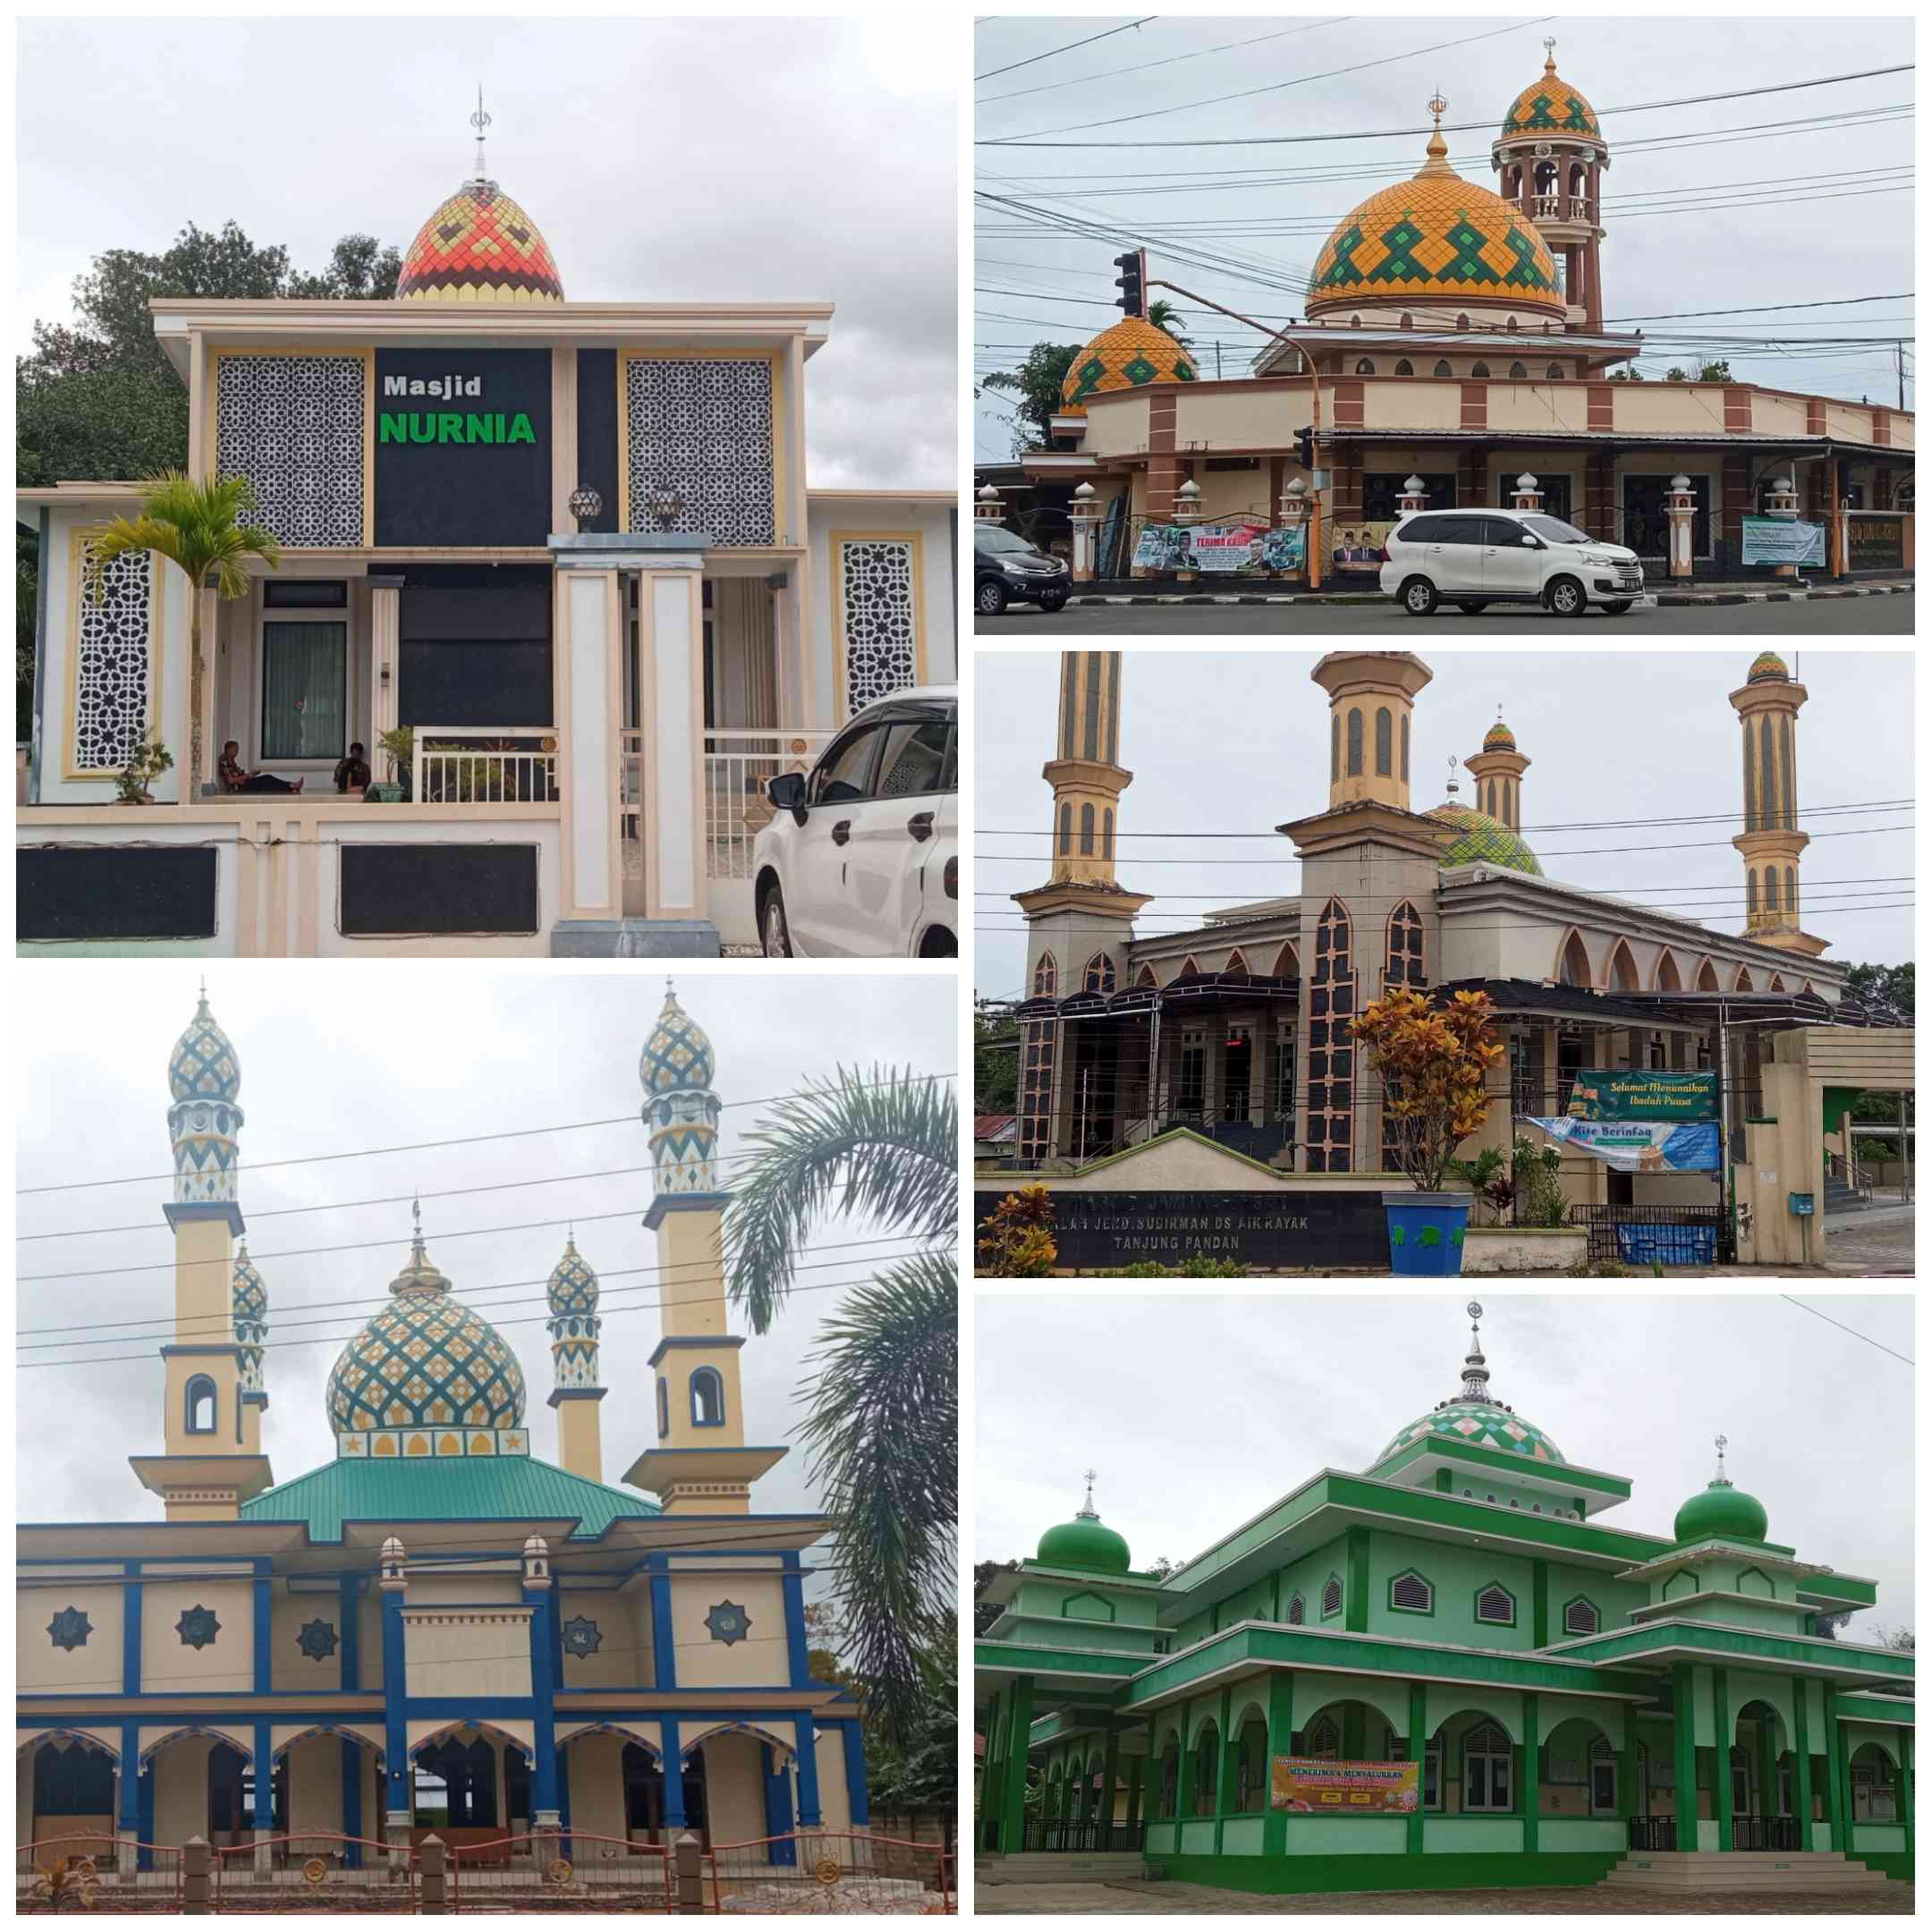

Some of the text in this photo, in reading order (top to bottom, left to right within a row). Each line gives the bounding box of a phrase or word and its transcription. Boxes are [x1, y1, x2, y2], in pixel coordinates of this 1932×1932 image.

[384, 375, 481, 401] Masjid
[379, 412, 537, 444] NURNIA
[1611, 1081, 1647, 1092] Selamat
[1631, 1096, 1661, 1106] Ibadah
[1602, 1125, 1653, 1138] Berinfaq
[1264, 1216, 1309, 1230] RAYAK
[1114, 1236, 1239, 1250] TANJUNG PANDAN
